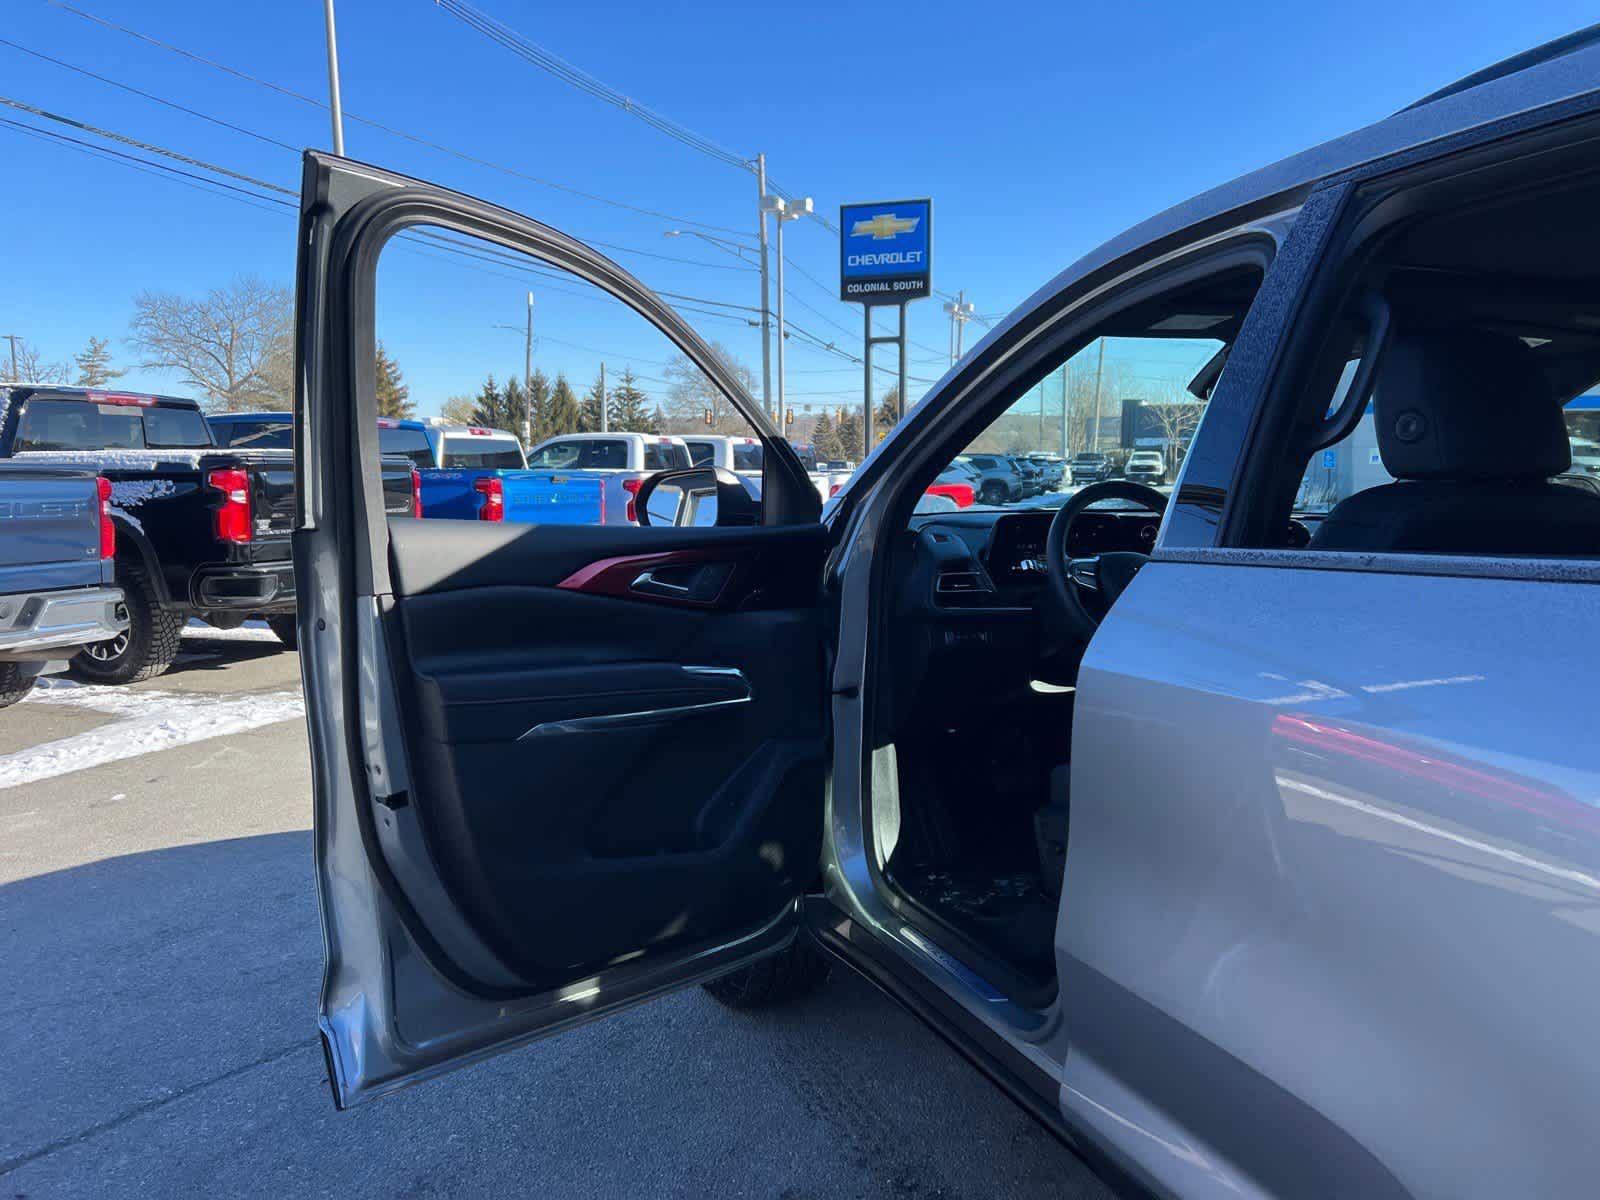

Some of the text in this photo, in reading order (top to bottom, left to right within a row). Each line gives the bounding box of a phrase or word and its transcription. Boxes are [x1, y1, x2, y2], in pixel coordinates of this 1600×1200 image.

[847, 251, 922, 266] CHEVROLET
[847, 280, 923, 293] COLONIAL SOUTH
